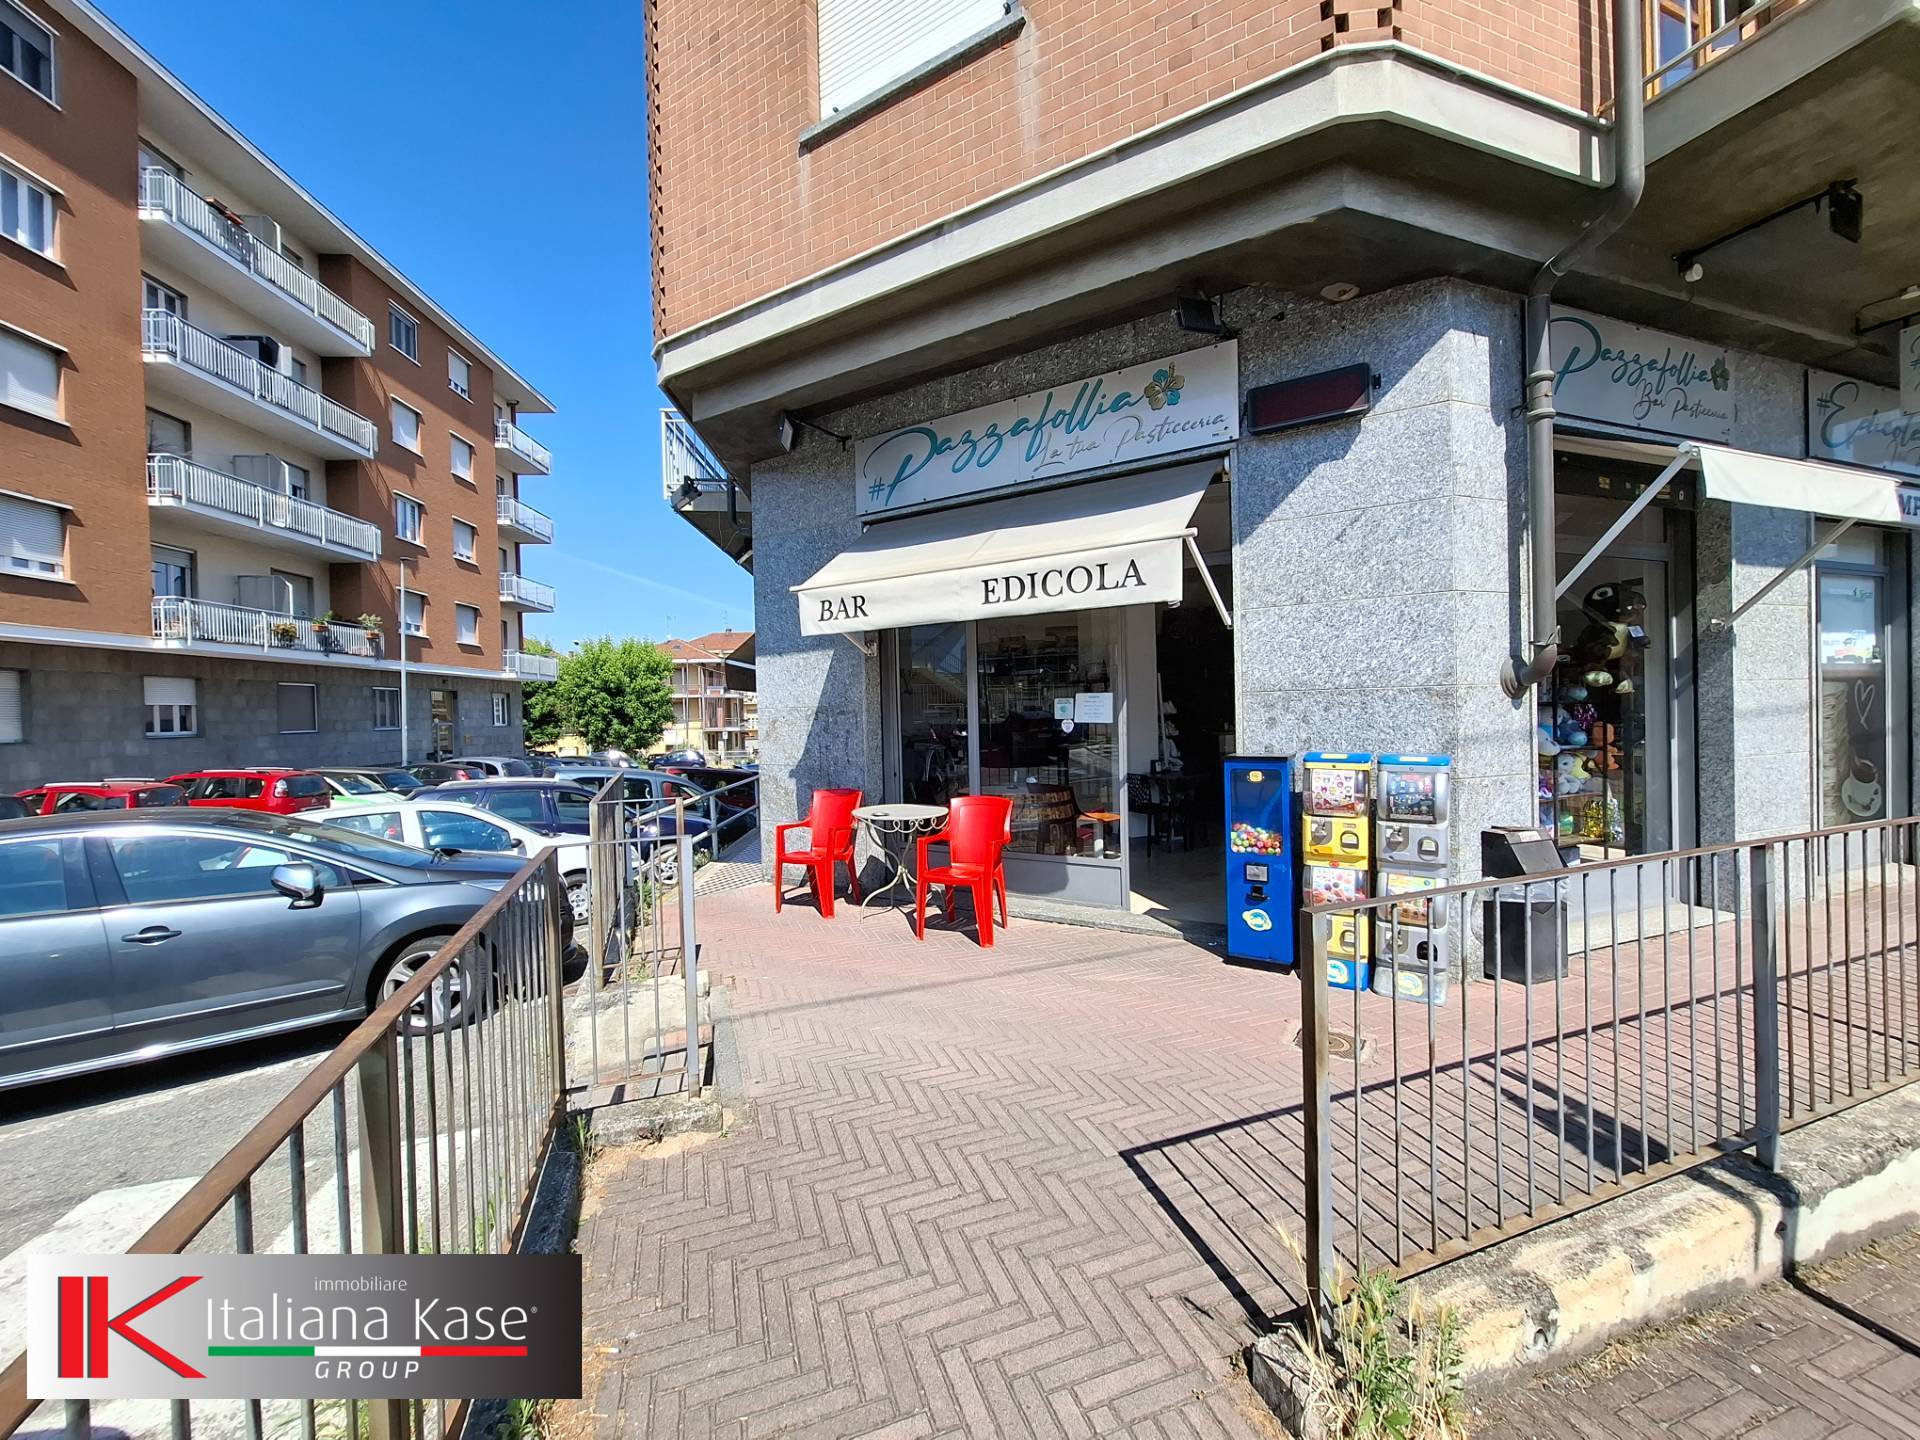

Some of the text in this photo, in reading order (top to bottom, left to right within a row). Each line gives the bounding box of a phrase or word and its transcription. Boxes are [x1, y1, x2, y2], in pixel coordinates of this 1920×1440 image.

[1033, 413, 1230, 472] La tua Pasticceria
[818, 558, 1146, 622] BAR EDICOLA
